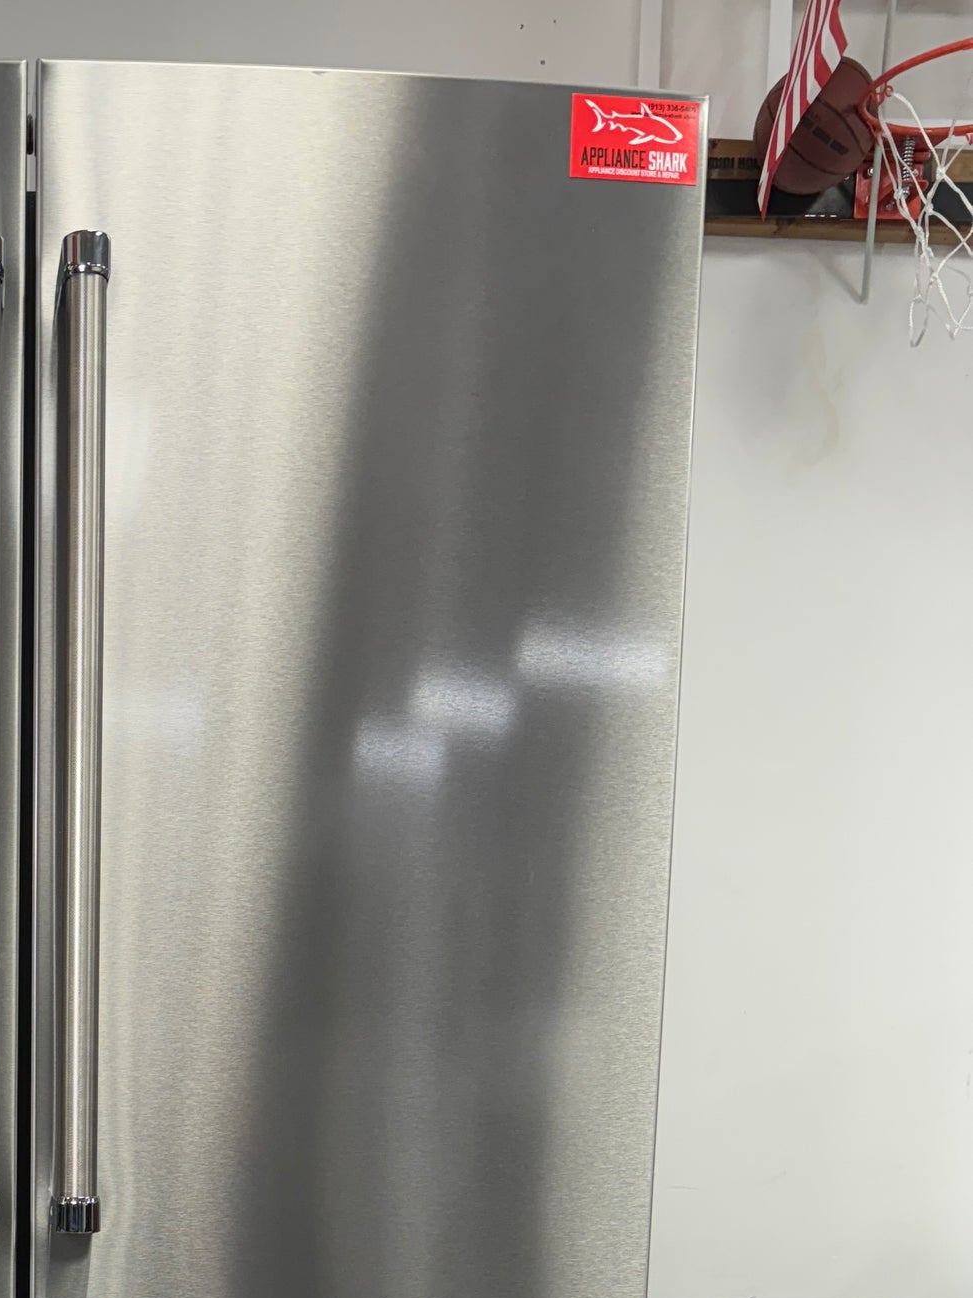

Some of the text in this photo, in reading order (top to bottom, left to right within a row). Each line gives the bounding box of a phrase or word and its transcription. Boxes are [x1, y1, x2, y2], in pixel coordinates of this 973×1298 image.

[580, 146, 646, 169] APPLIANCE
[648, 150, 688, 173] SHARK
[588, 166, 615, 175] APPLIANCE
[616, 168, 640, 176] DISCOUNT
[640, 169, 657, 177] STORE
[662, 171, 680, 179] REPAIR
